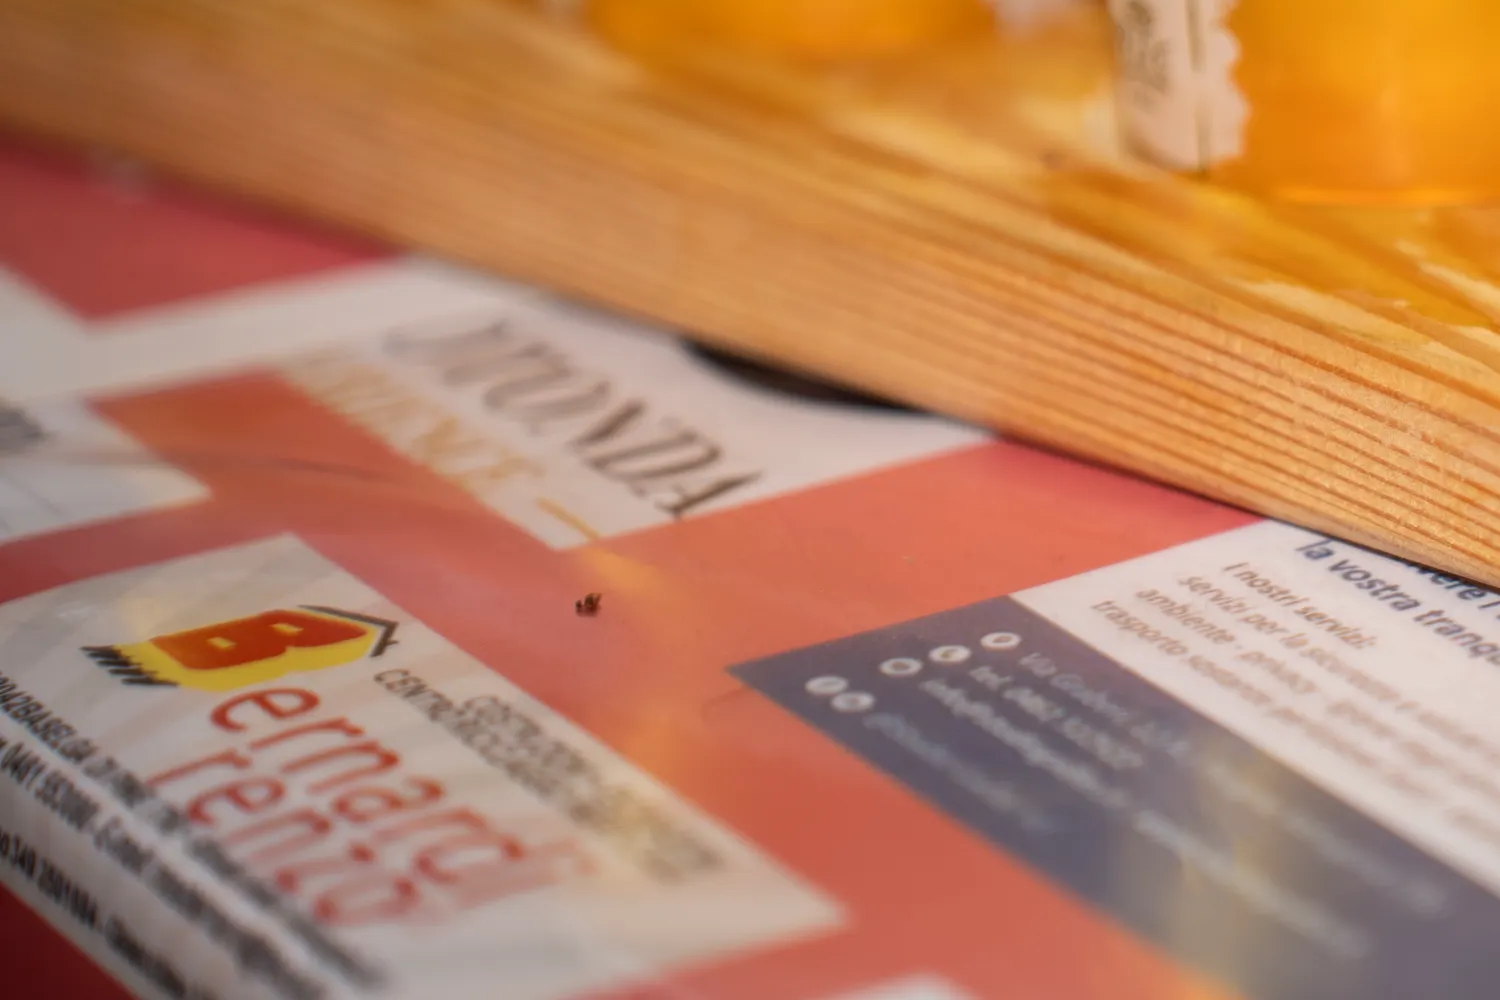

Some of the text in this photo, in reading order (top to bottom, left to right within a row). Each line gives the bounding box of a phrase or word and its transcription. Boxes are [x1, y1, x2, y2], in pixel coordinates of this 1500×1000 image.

[1236, 567, 1310, 610] nostri
[1295, 540, 1335, 562] la
[1327, 558, 1422, 612] vostra
[1134, 587, 1237, 647] ambiente
